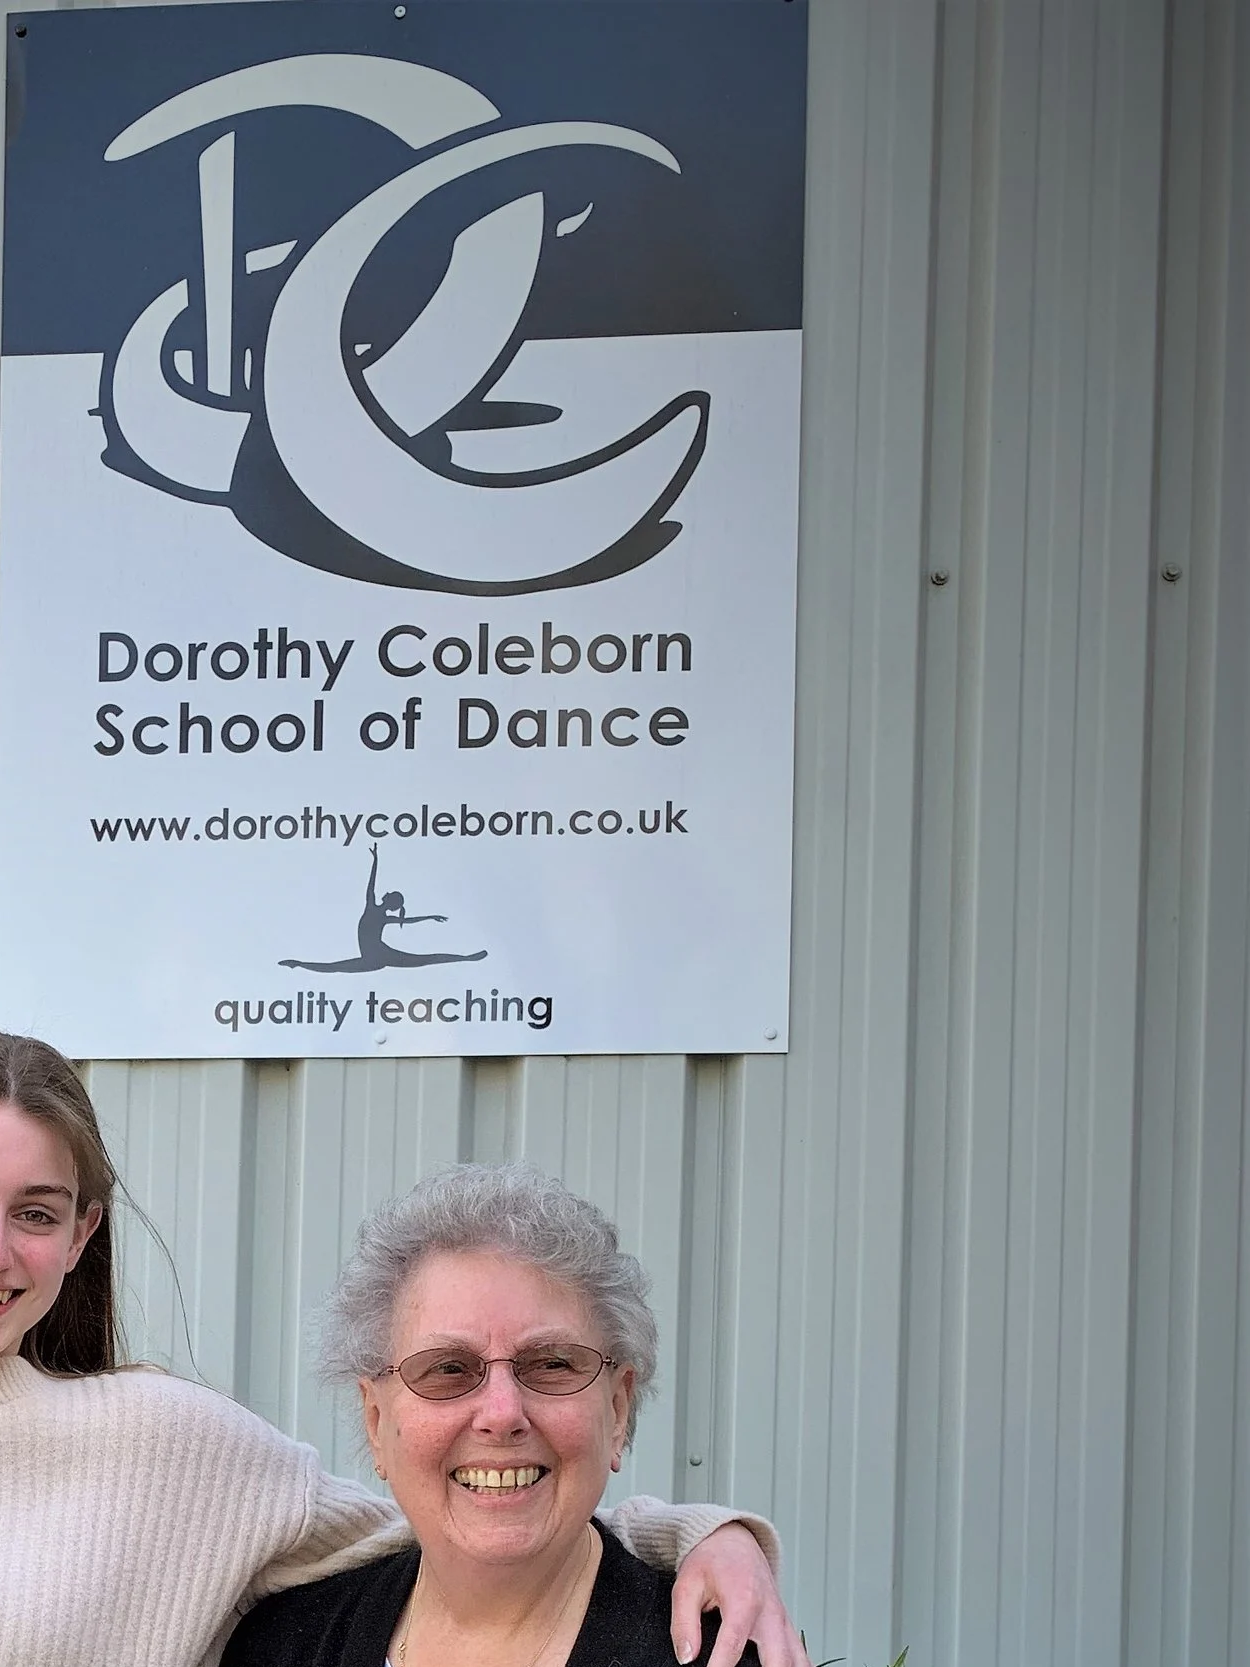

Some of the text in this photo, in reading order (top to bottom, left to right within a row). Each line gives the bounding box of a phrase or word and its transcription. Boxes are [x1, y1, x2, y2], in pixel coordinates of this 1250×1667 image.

[98, 621, 692, 692] Dorothy Coleborn
[93, 696, 690, 757] School of Dance
[90, 800, 689, 846] www.dorothycoleborn.co.uk
[214, 988, 553, 1032] quality teaching
